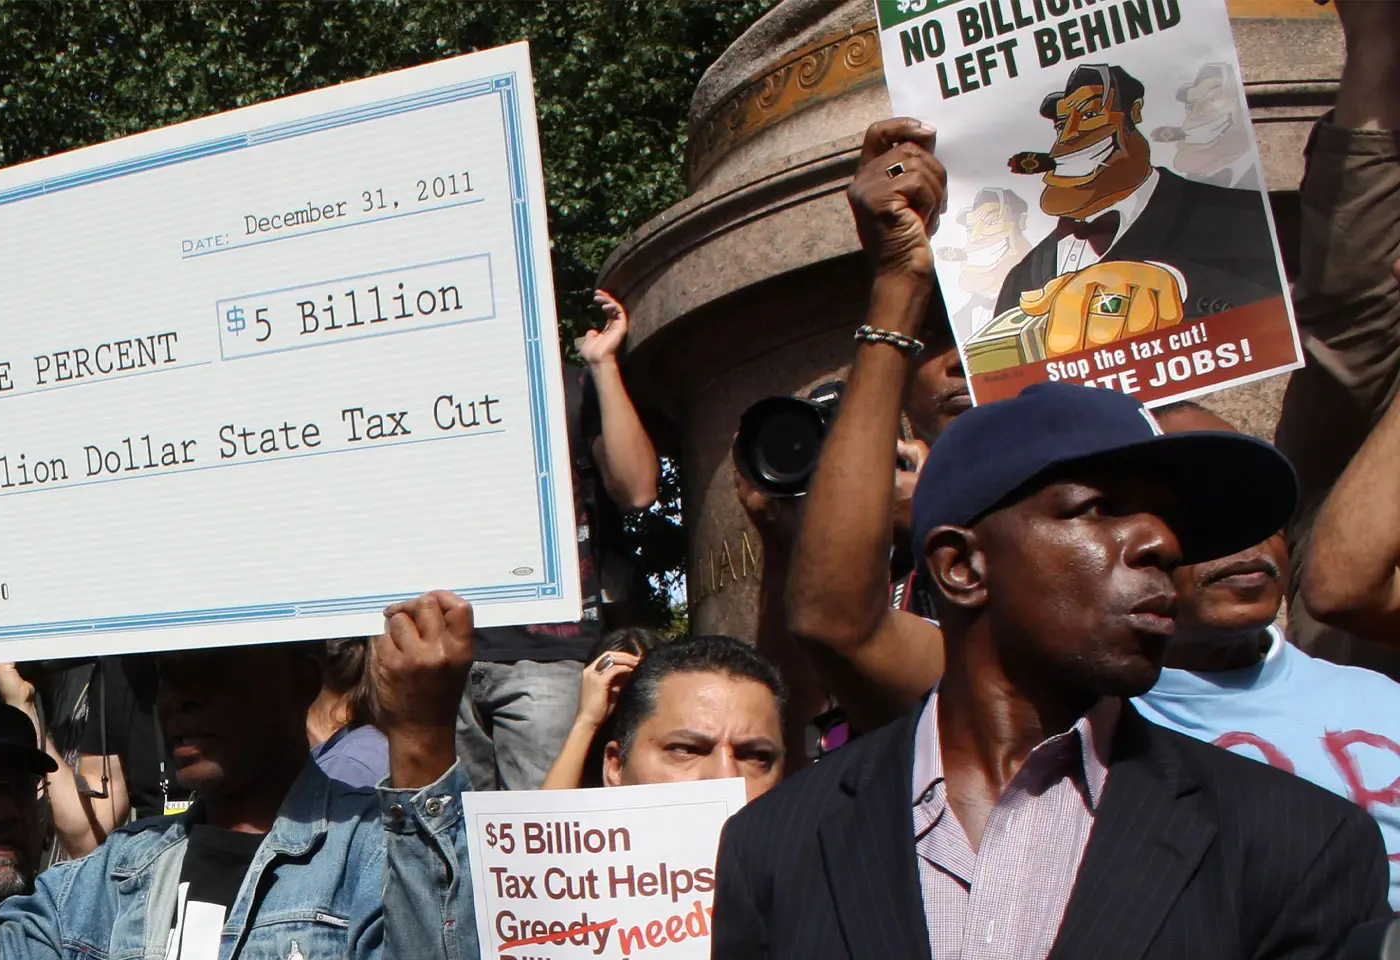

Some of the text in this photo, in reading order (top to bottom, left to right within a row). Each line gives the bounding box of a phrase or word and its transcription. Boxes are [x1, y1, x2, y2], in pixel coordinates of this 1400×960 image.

[900, 19, 946, 67] NO
[936, 0, 1181, 100] LEFT BEHIND
[244, 200, 348, 235] December
[362, 188, 399, 212] 31,
[416, 171, 475, 202] 2011
[296, 282, 464, 336] Billion
[34, 332, 178, 386] PERCENT
[1046, 359, 1090, 383] Stop
[1094, 346, 1126, 368] the
[1132, 337, 1164, 361] tax
[1168, 322, 1208, 351] cut!
[1149, 338, 1253, 388] JOBS!
[83, 434, 197, 478] Dollar
[218, 421, 322, 459] State
[341, 407, 412, 442] Tax
[433, 394, 504, 430] Cut
[485, 821, 631, 855] $5 Billion
[489, 862, 715, 902] Tax Cut Helps
[495, 910, 612, 955] Greedy
